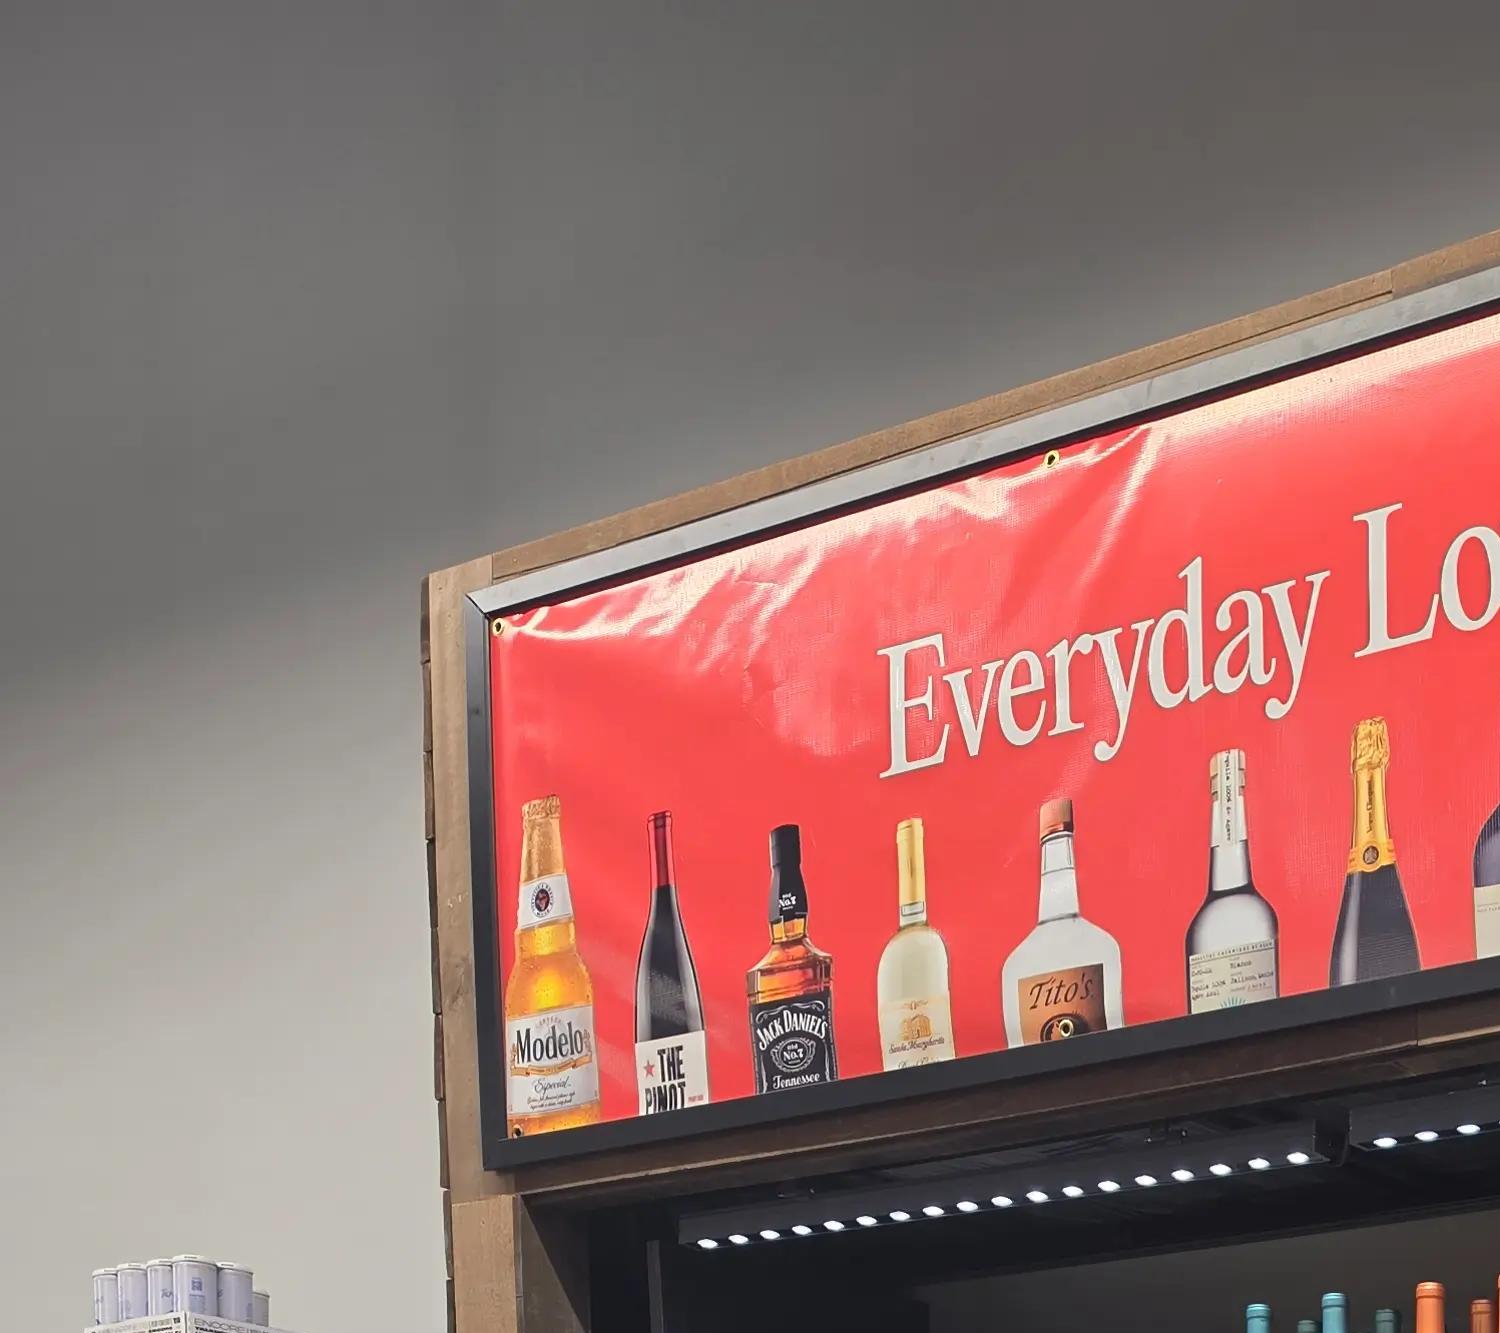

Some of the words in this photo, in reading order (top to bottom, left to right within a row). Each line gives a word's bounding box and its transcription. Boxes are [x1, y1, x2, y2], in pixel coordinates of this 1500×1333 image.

[876, 556, 1331, 779] Everyday
[515, 1021, 585, 1064] Modelo
[756, 1020, 784, 1051] JACK
[783, 1010, 829, 1040] DANIEL'S
[657, 1045, 685, 1083] THE
[772, 1072, 821, 1089] Tennessee
[645, 1082, 687, 1114] PINOT
